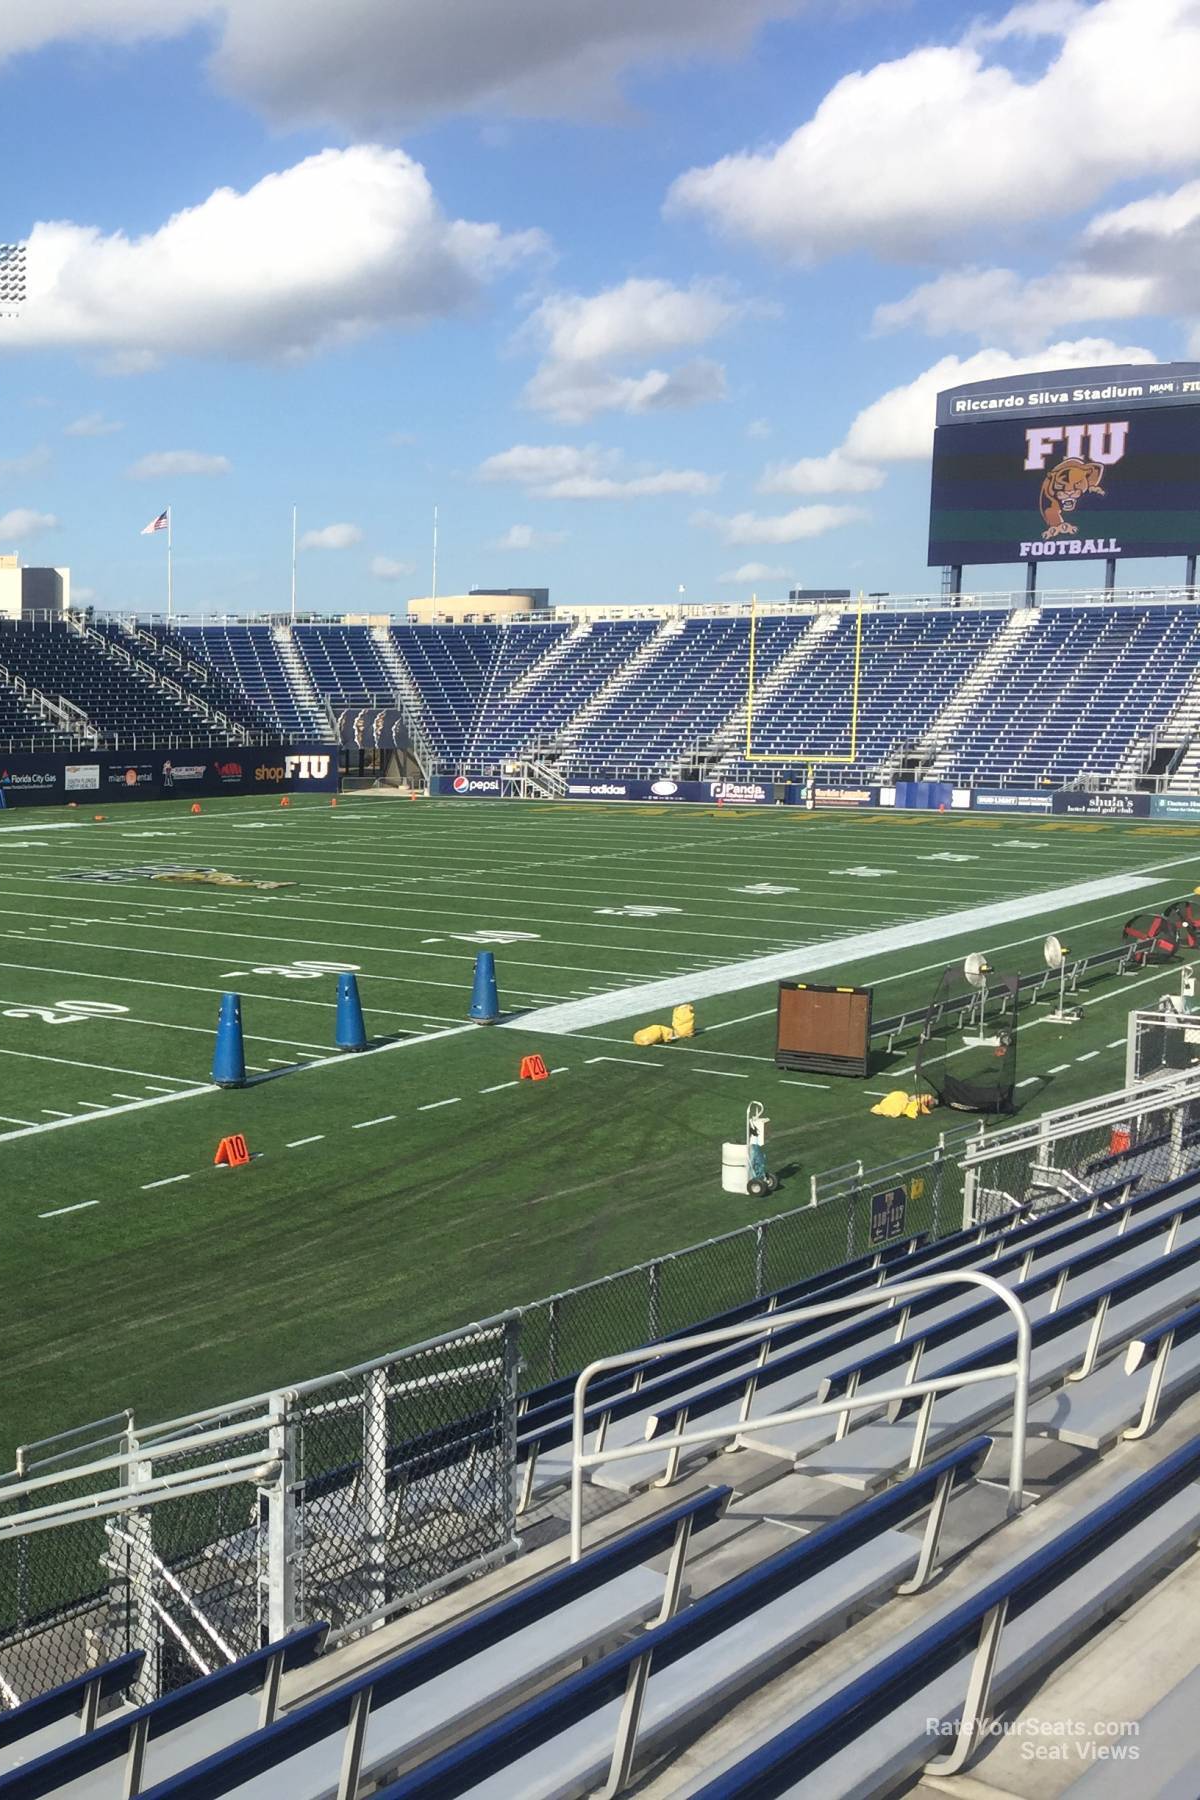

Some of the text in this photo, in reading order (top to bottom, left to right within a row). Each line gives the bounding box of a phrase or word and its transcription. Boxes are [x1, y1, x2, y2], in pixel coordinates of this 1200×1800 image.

[956, 396, 1024, 411] Riccardo
[1028, 392, 1069, 405] Silva
[1073, 386, 1142, 401] Stadium
[1024, 421, 1129, 470] FIU
[1019, 538, 1121, 556] FOOTBALL
[11, 773, 56, 784] Florida City Gas
[469, 779, 499, 791] pepsi
[590, 785, 626, 795] adidas
[1089, 795, 1133, 807] shula's
[252, 961, 361, 979] 30
[2, 1000, 131, 1024] 20
[529, 1056, 545, 1075] 20
[230, 1136, 246, 1160] 10
